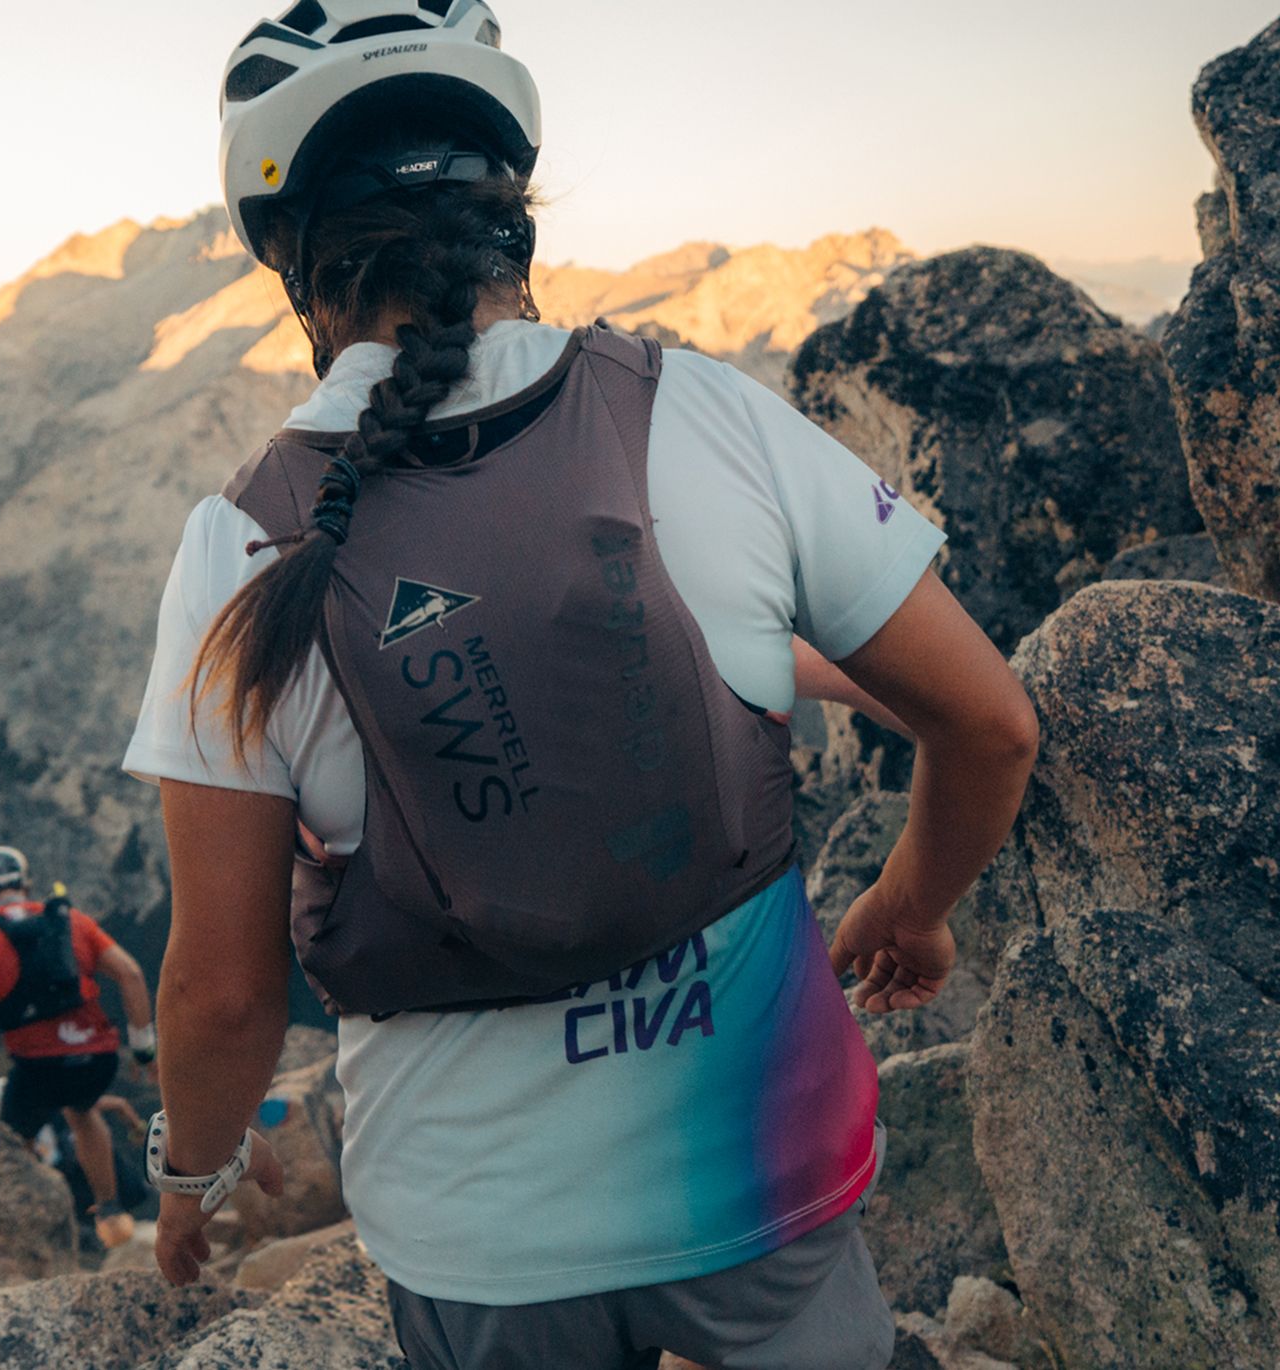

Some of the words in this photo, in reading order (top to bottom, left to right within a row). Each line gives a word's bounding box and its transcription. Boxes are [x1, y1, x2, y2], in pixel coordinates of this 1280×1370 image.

[362, 43, 428, 61] SPECIALIZED
[401, 649, 512, 822] SWS
[464, 635, 539, 813] MERRELL
[564, 980, 715, 1064] CIVA
